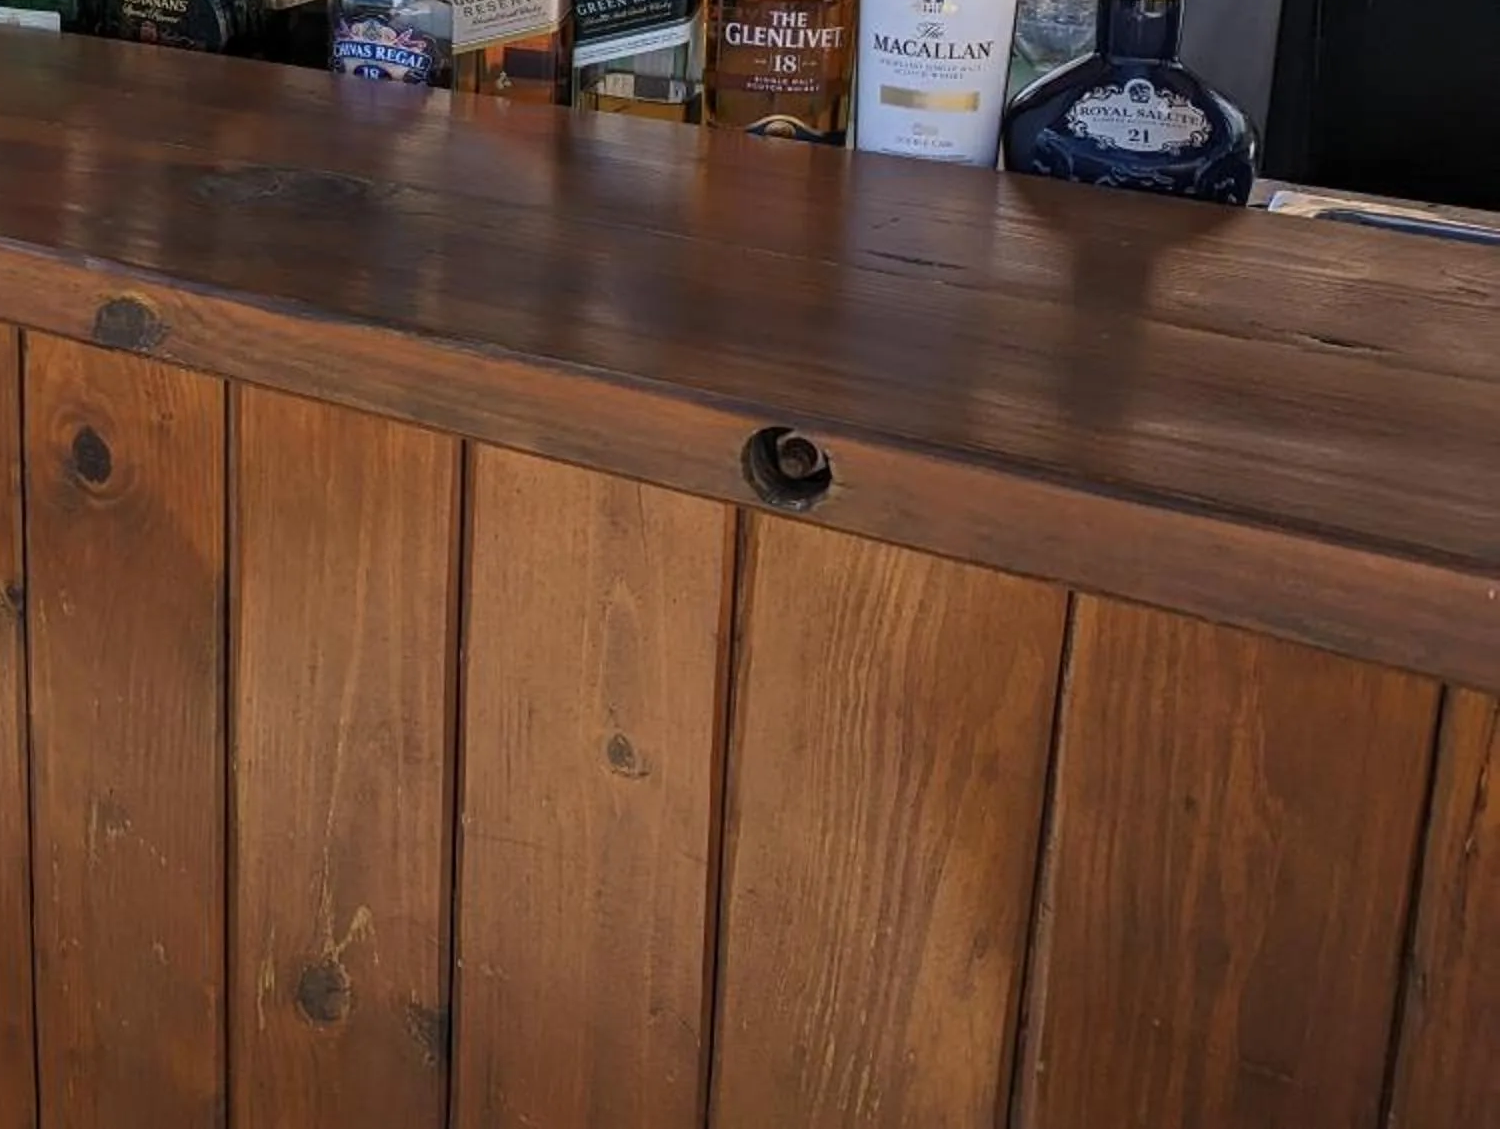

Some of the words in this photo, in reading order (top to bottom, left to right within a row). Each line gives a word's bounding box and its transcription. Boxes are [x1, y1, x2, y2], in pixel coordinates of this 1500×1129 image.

[769, 10, 809, 28] THE
[725, 23, 845, 49] GLENLIVET
[915, 22, 945, 40] The
[873, 33, 995, 61] MACALLAN
[375, 47, 427, 69] REGAL
[773, 54, 798, 72] 18
[1079, 106, 1133, 118] ROYAL
[1136, 108, 1201, 127] SALUTE
[1127, 128, 1150, 144] 21
